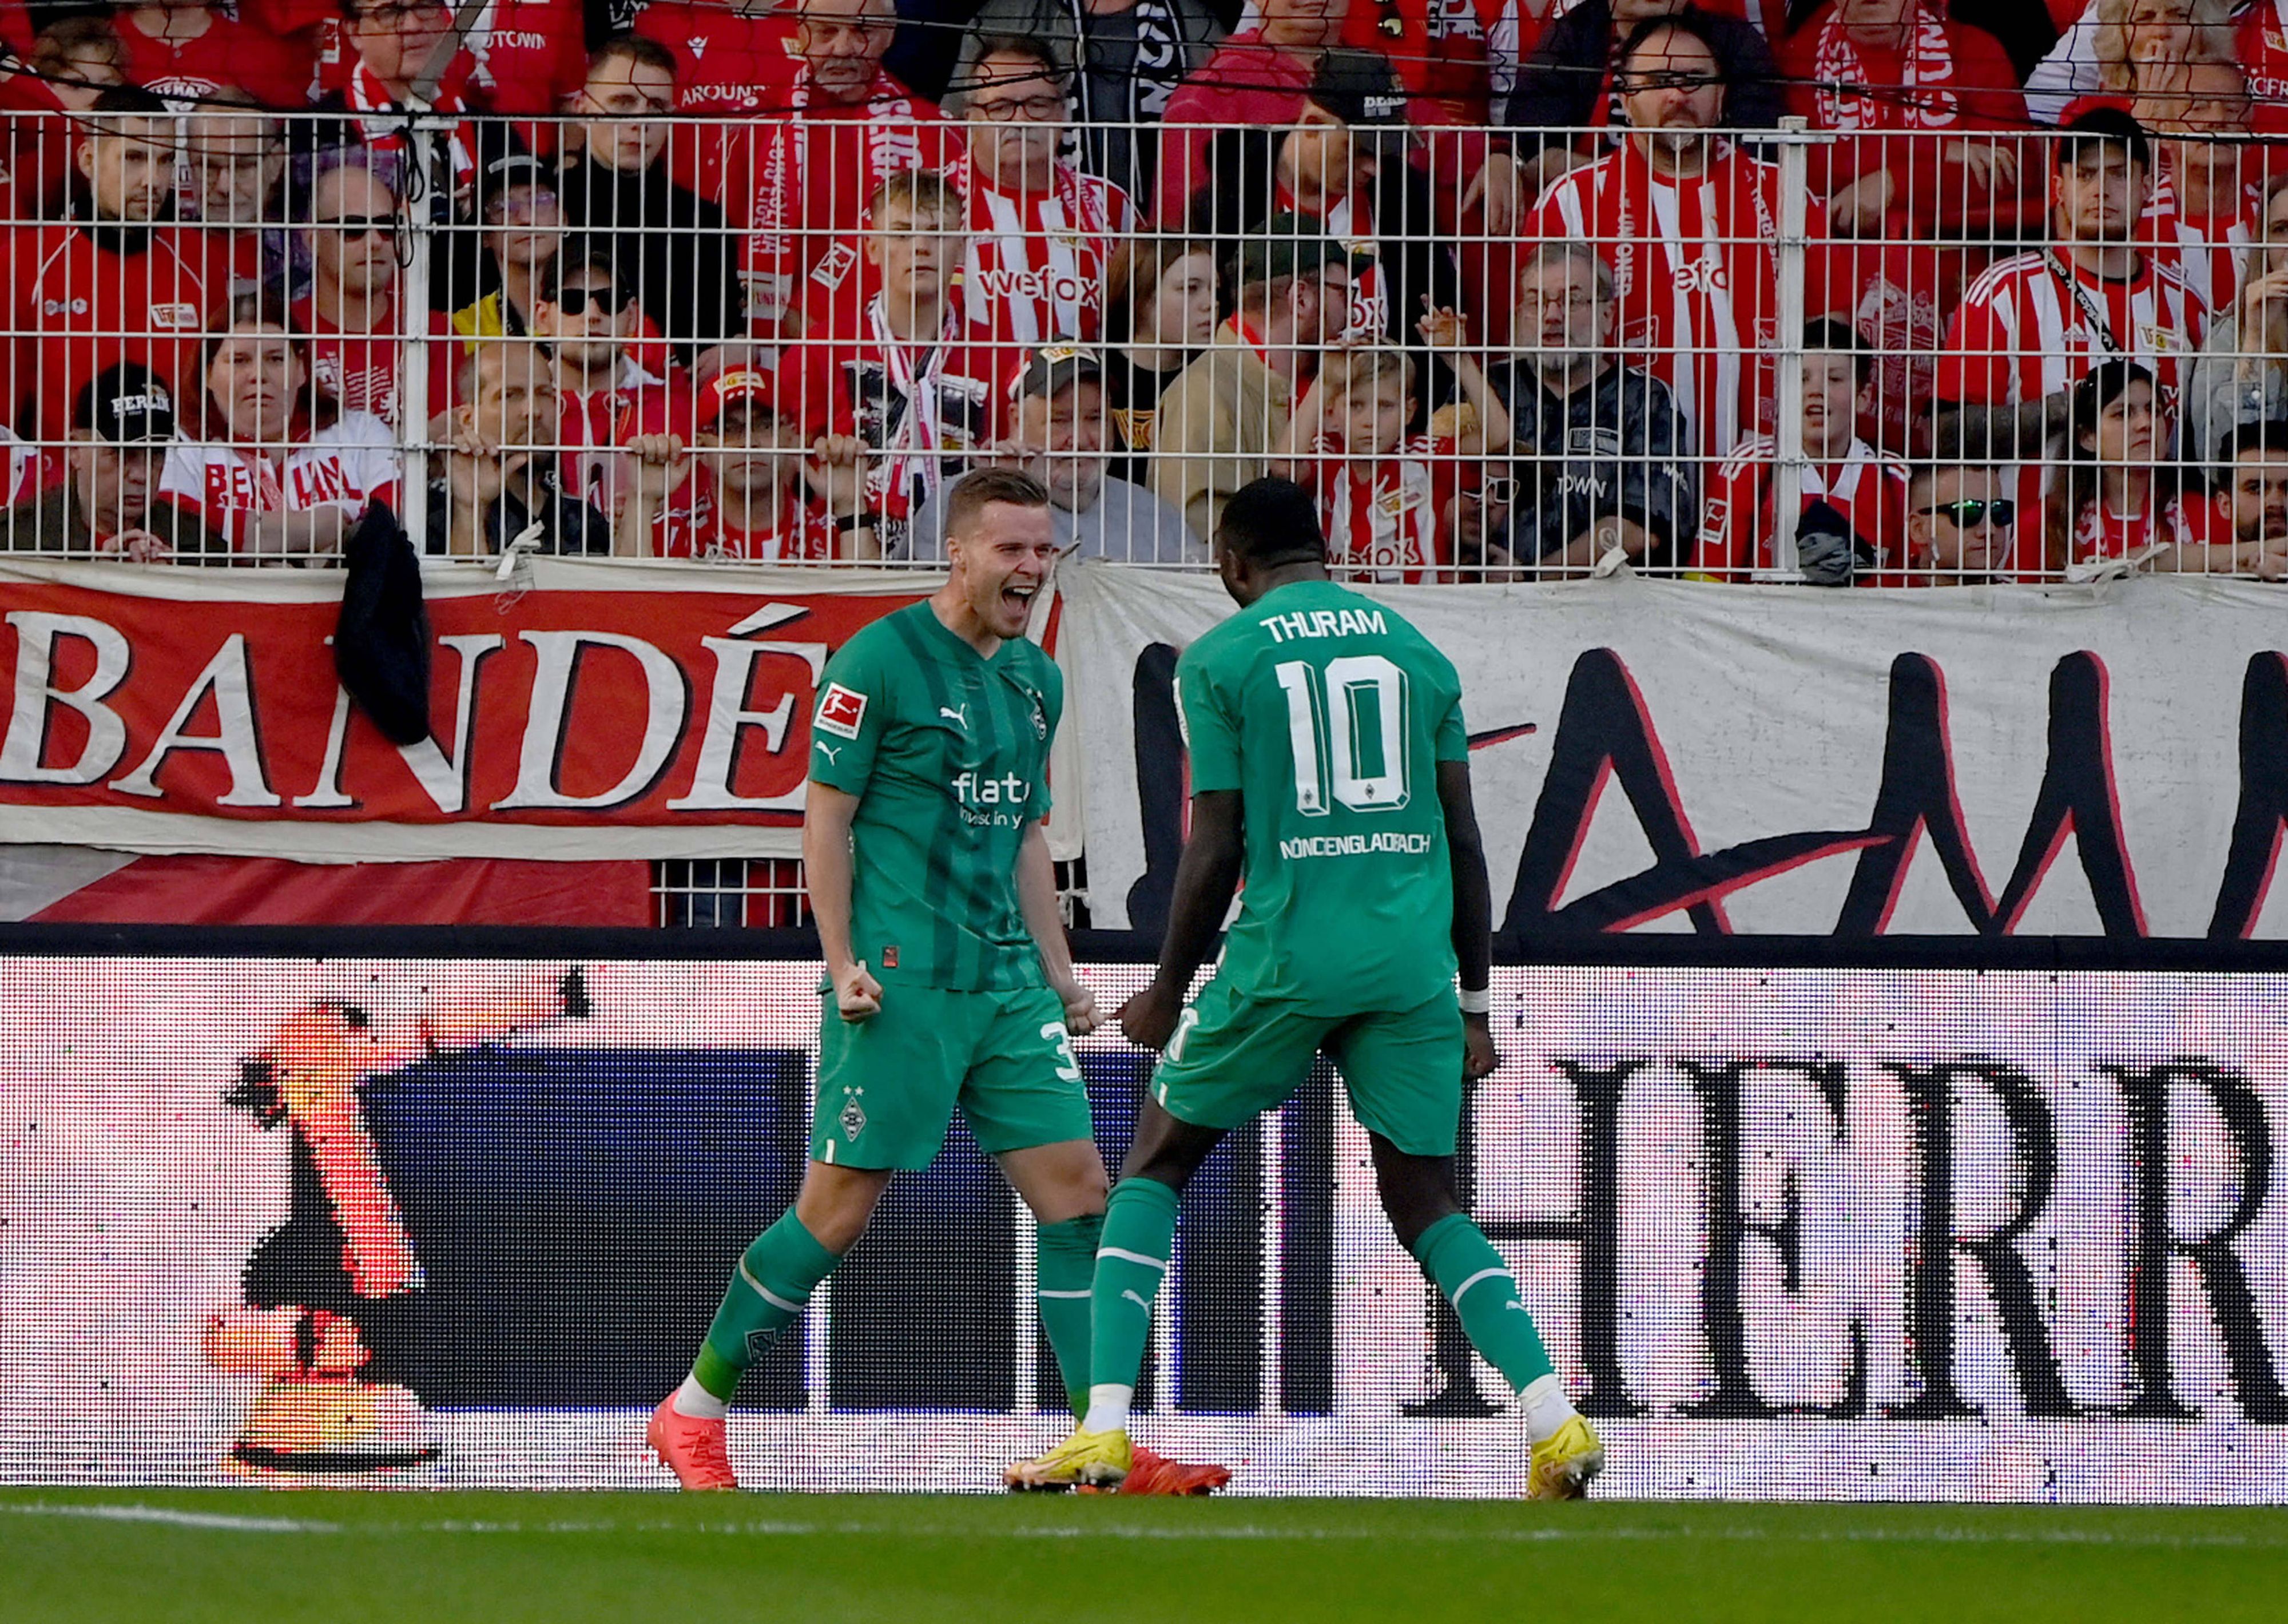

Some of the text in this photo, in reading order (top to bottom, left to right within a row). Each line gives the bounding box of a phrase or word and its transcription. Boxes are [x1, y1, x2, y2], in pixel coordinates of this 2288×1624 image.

[975, 265, 1101, 310] wefox
[1259, 609, 1388, 643] THURAM
[1274, 655, 1411, 817] 10
